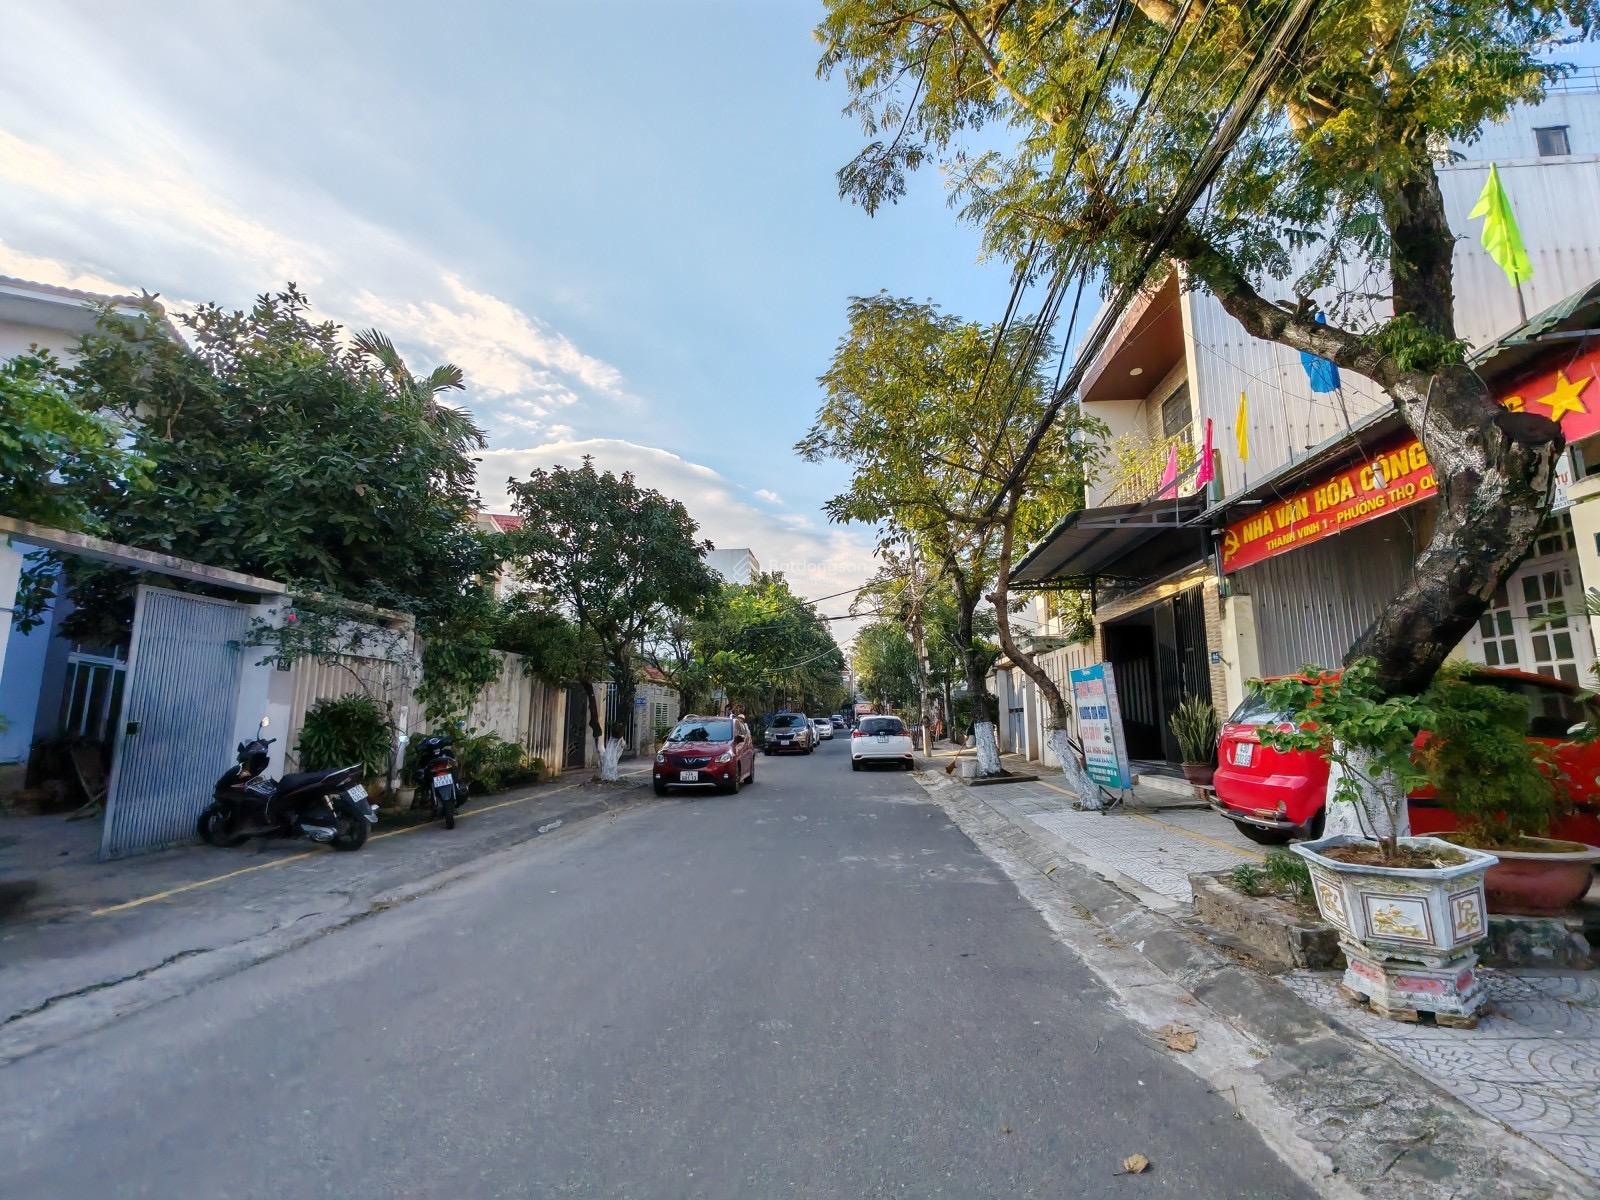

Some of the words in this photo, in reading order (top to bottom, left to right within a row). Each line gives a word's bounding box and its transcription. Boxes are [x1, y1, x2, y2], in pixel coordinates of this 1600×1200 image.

[1243, 511, 1274, 543] NHÀ
[1275, 497, 1309, 529] VĂN
[1314, 476, 1355, 512] HÓA
[1297, 521, 1321, 539] VINH
[1322, 519, 1328, 529] 1
[1388, 483, 1416, 502] THỌ
